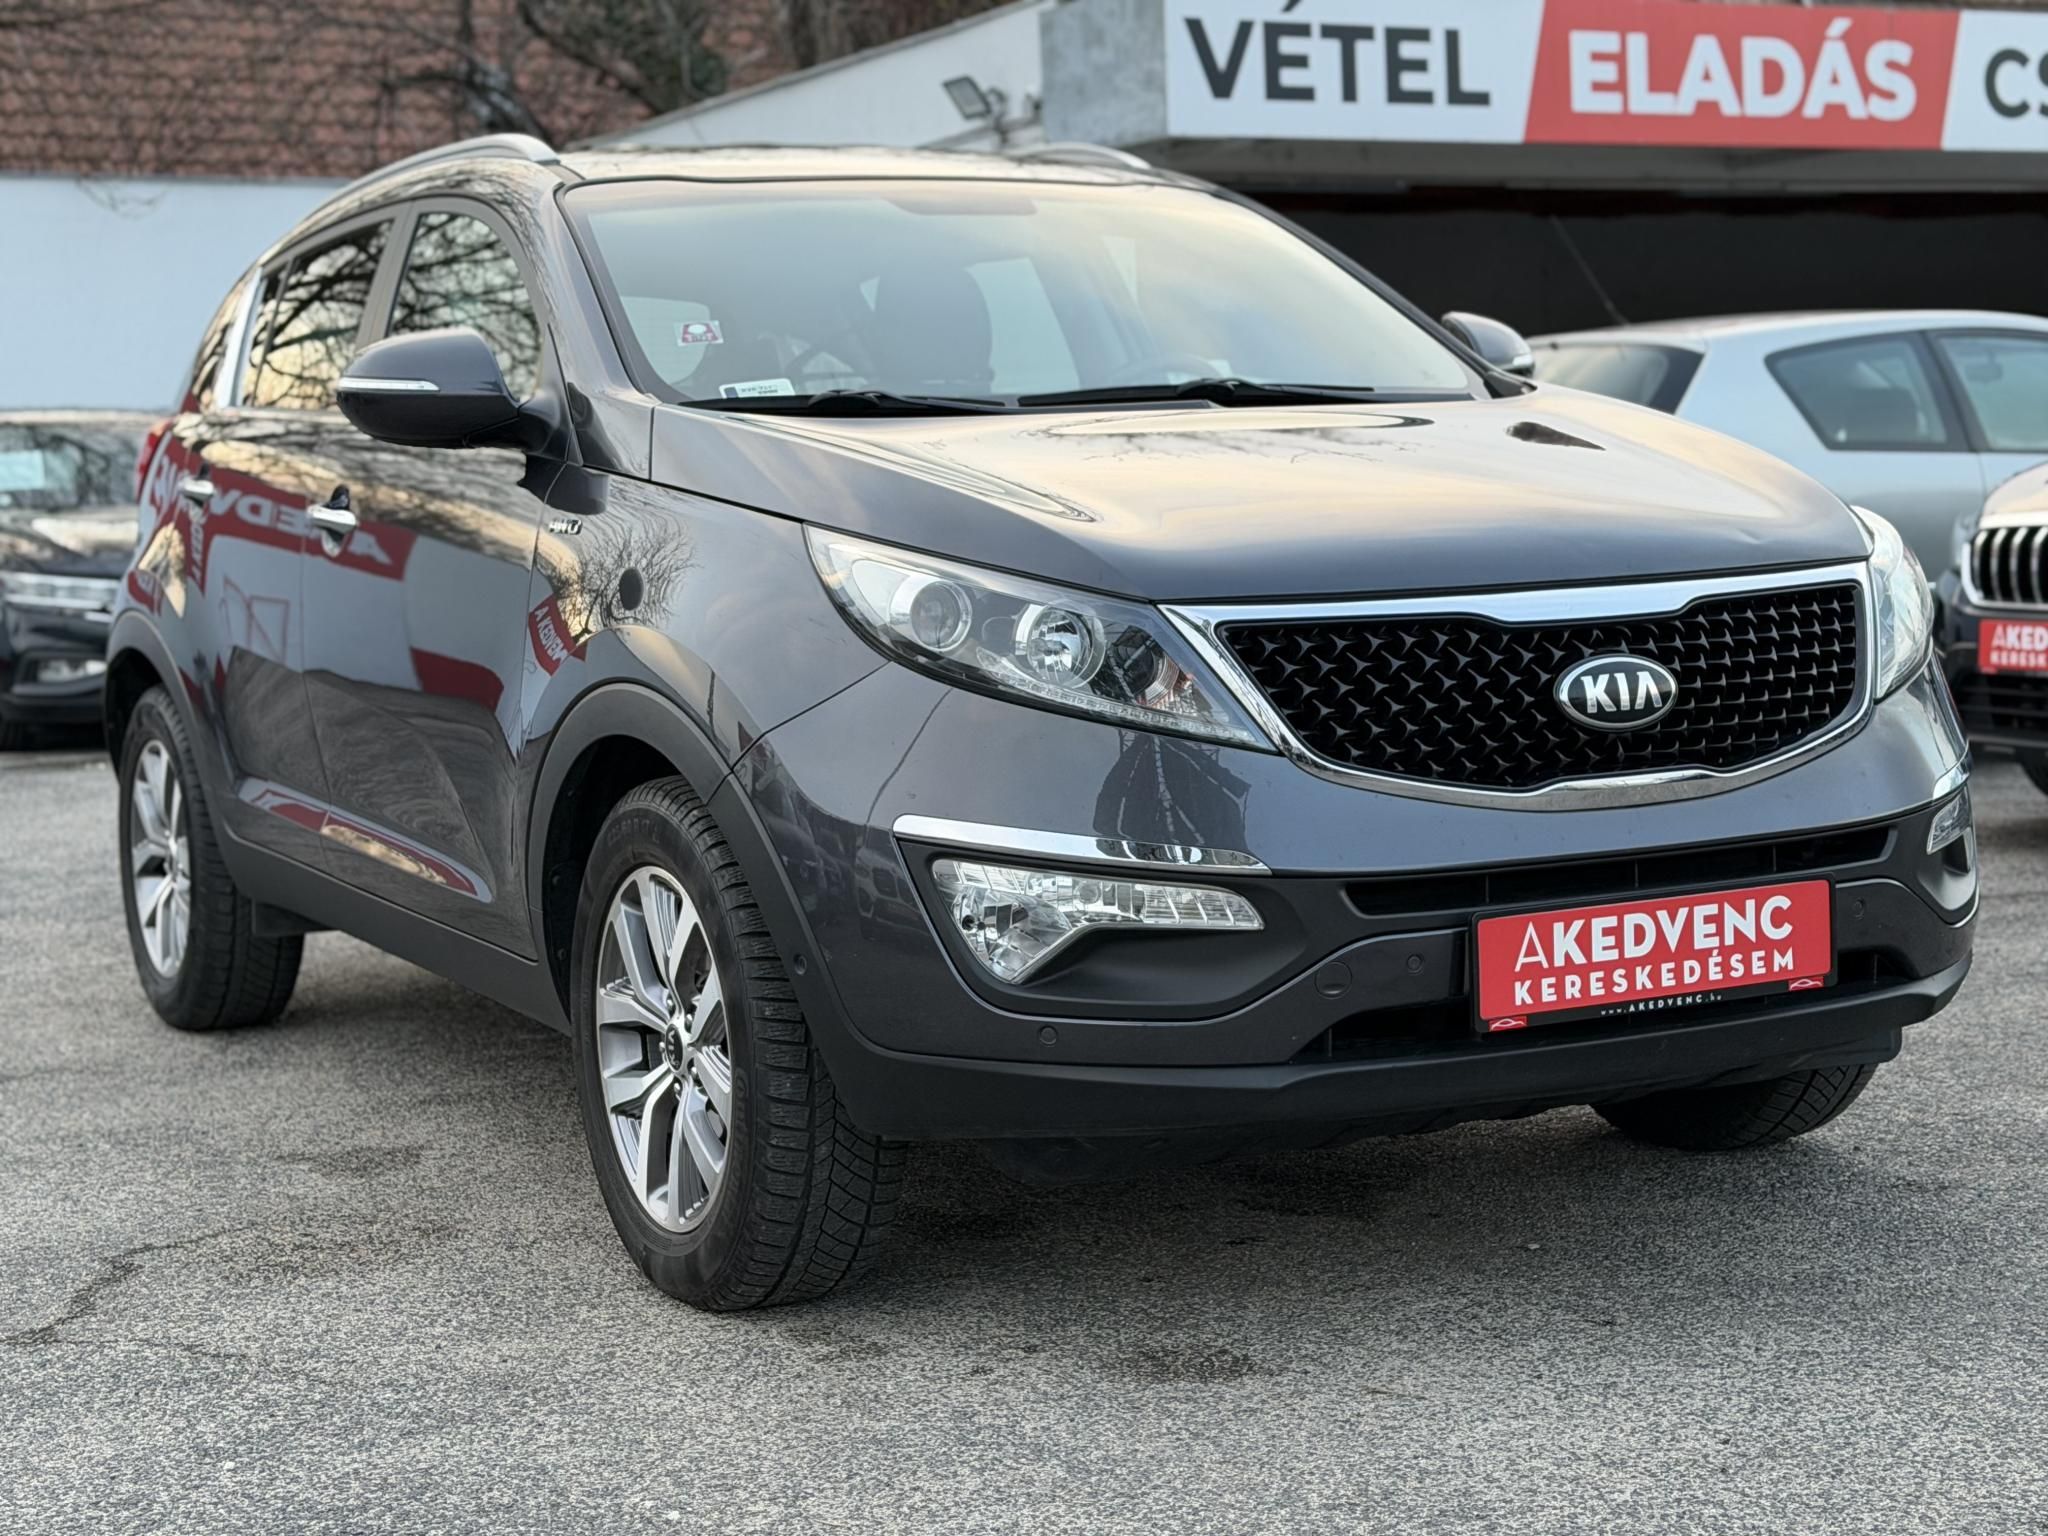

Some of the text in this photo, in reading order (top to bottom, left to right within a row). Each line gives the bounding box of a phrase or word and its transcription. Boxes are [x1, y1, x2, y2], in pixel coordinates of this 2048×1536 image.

[1184, 0, 2048, 121] VÉTEL ELADÁS C
[1580, 671, 1662, 714] KIA
[1514, 947, 1794, 1006] KERESKEDÉSEM
